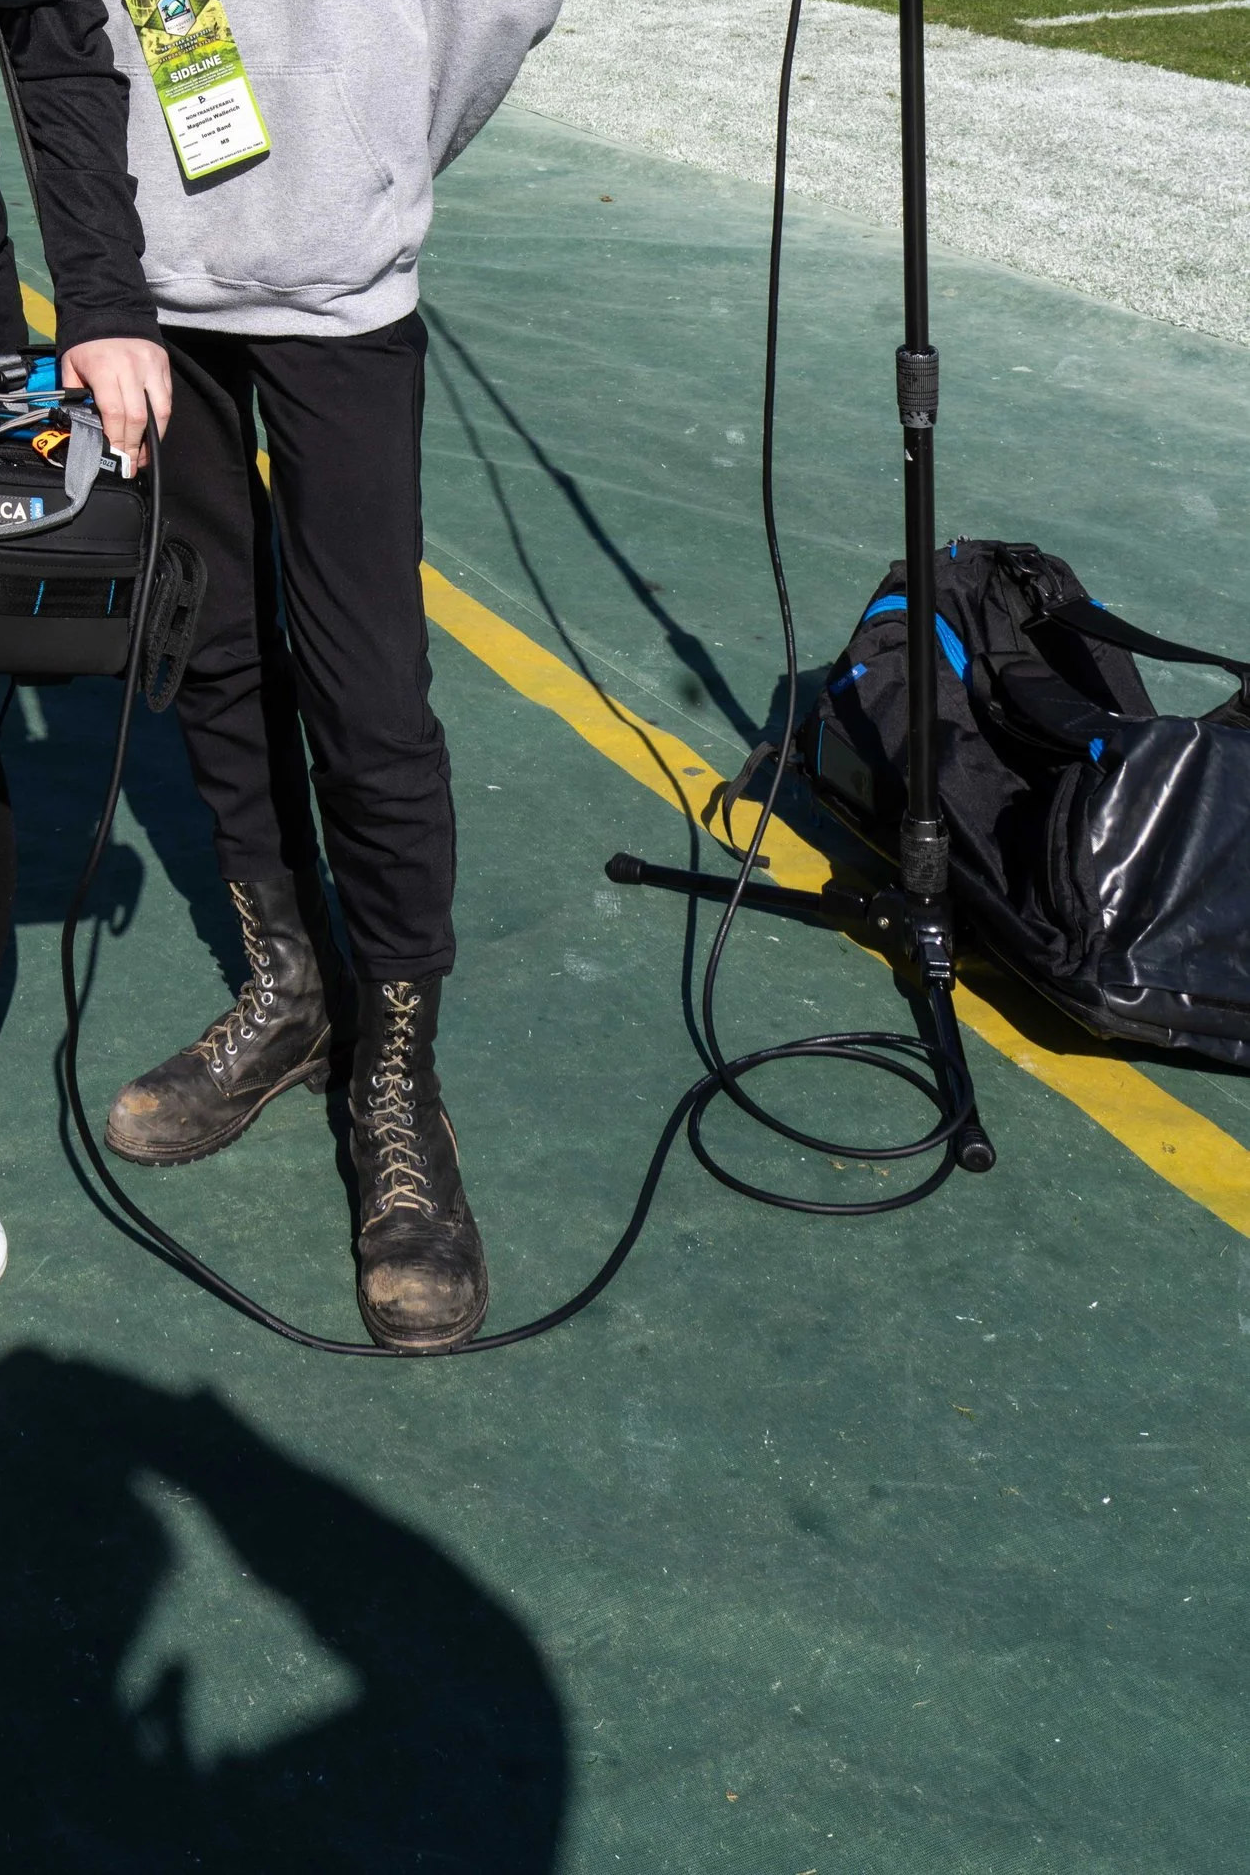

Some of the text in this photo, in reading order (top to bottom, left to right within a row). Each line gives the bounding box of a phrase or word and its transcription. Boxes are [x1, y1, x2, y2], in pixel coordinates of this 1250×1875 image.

[170, 54, 222, 83] SIDELINE
[197, 95, 206, 104] B
[201, 123, 232, 139] Iowa Band
